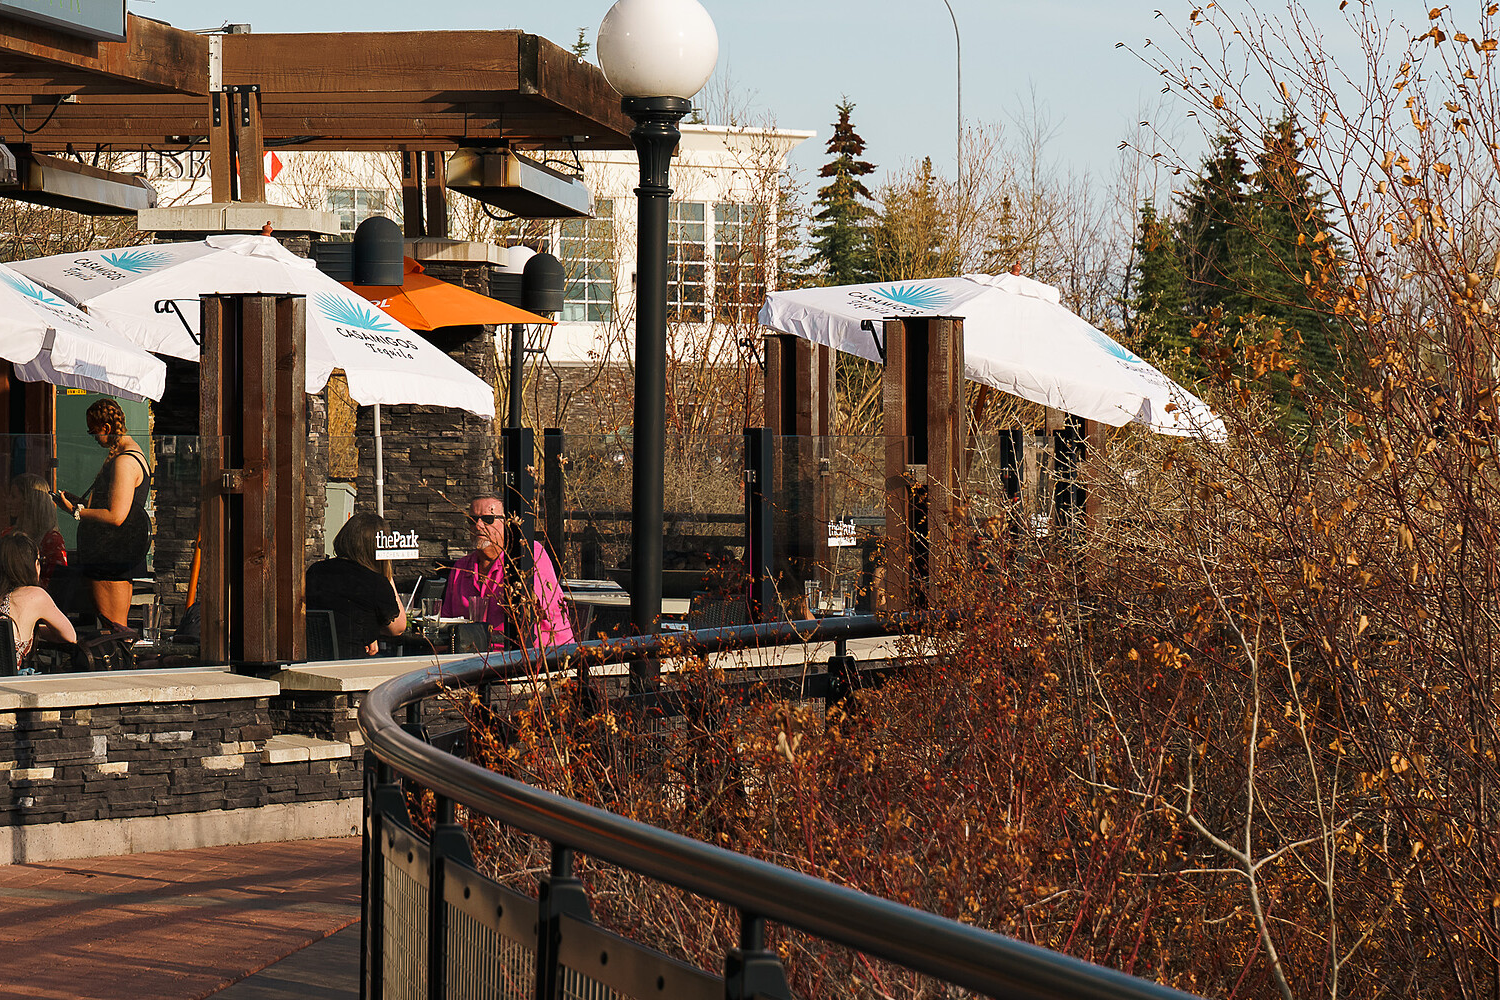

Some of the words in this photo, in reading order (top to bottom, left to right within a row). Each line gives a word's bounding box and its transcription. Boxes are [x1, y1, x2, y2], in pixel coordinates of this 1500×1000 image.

[142, 151, 212, 179] HSB
[848, 292, 924, 315] CASAMIGOS
[336, 327, 419, 350] CASAMIGOS
[365, 343, 414, 359] Tequila
[375, 530, 419, 548] thePark
